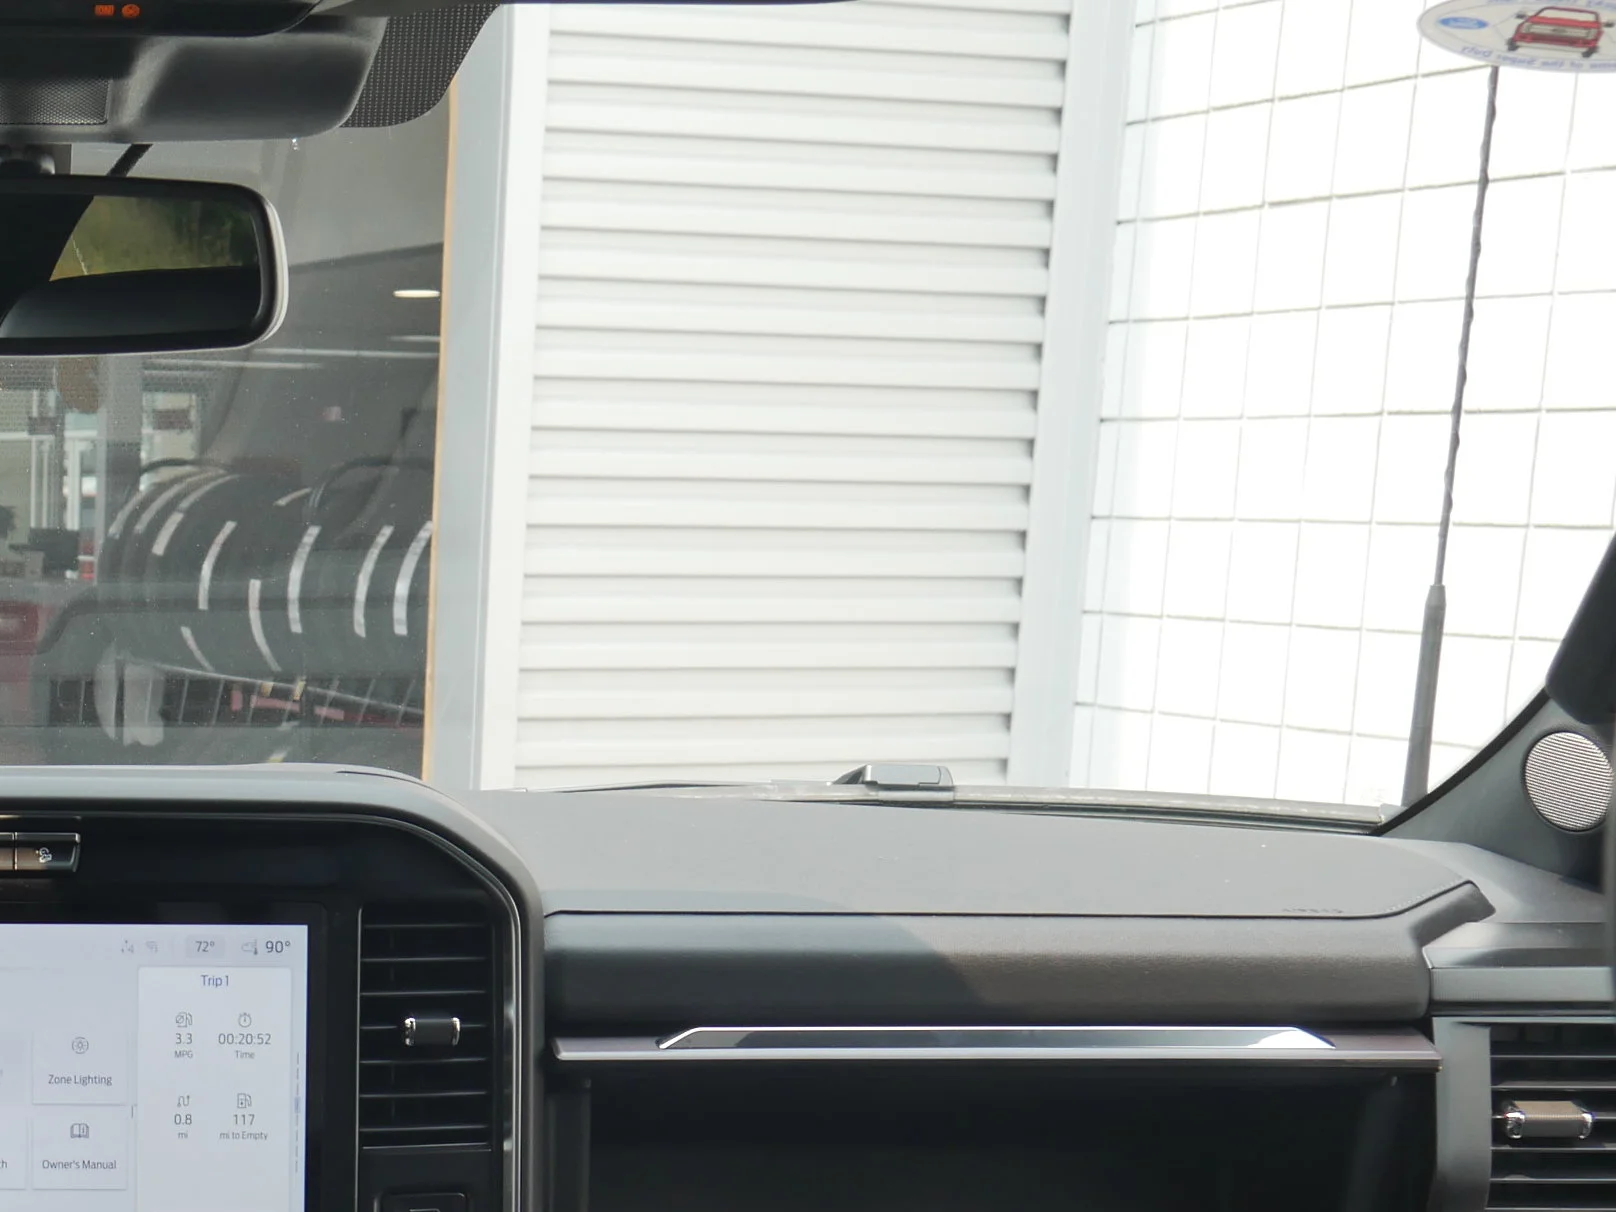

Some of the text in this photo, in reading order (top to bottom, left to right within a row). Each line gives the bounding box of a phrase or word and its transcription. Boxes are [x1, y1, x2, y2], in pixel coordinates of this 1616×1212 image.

[265, 941, 291, 953] 90°
[201, 975, 223, 988] Trip
[175, 1033, 193, 1044] 3.3
[218, 1033, 271, 1045] 00:20:52
[174, 1049, 193, 1059] MPG
[234, 1049, 255, 1059] Time
[48, 1074, 112, 1087] Zone Lighting
[174, 1114, 192, 1126] 0.8
[234, 1114, 255, 1126] 117
[178, 1130, 188, 1139] mi
[219, 1130, 268, 1142] mi to Empty
[42, 1159, 116, 1171] Owner's Manual
